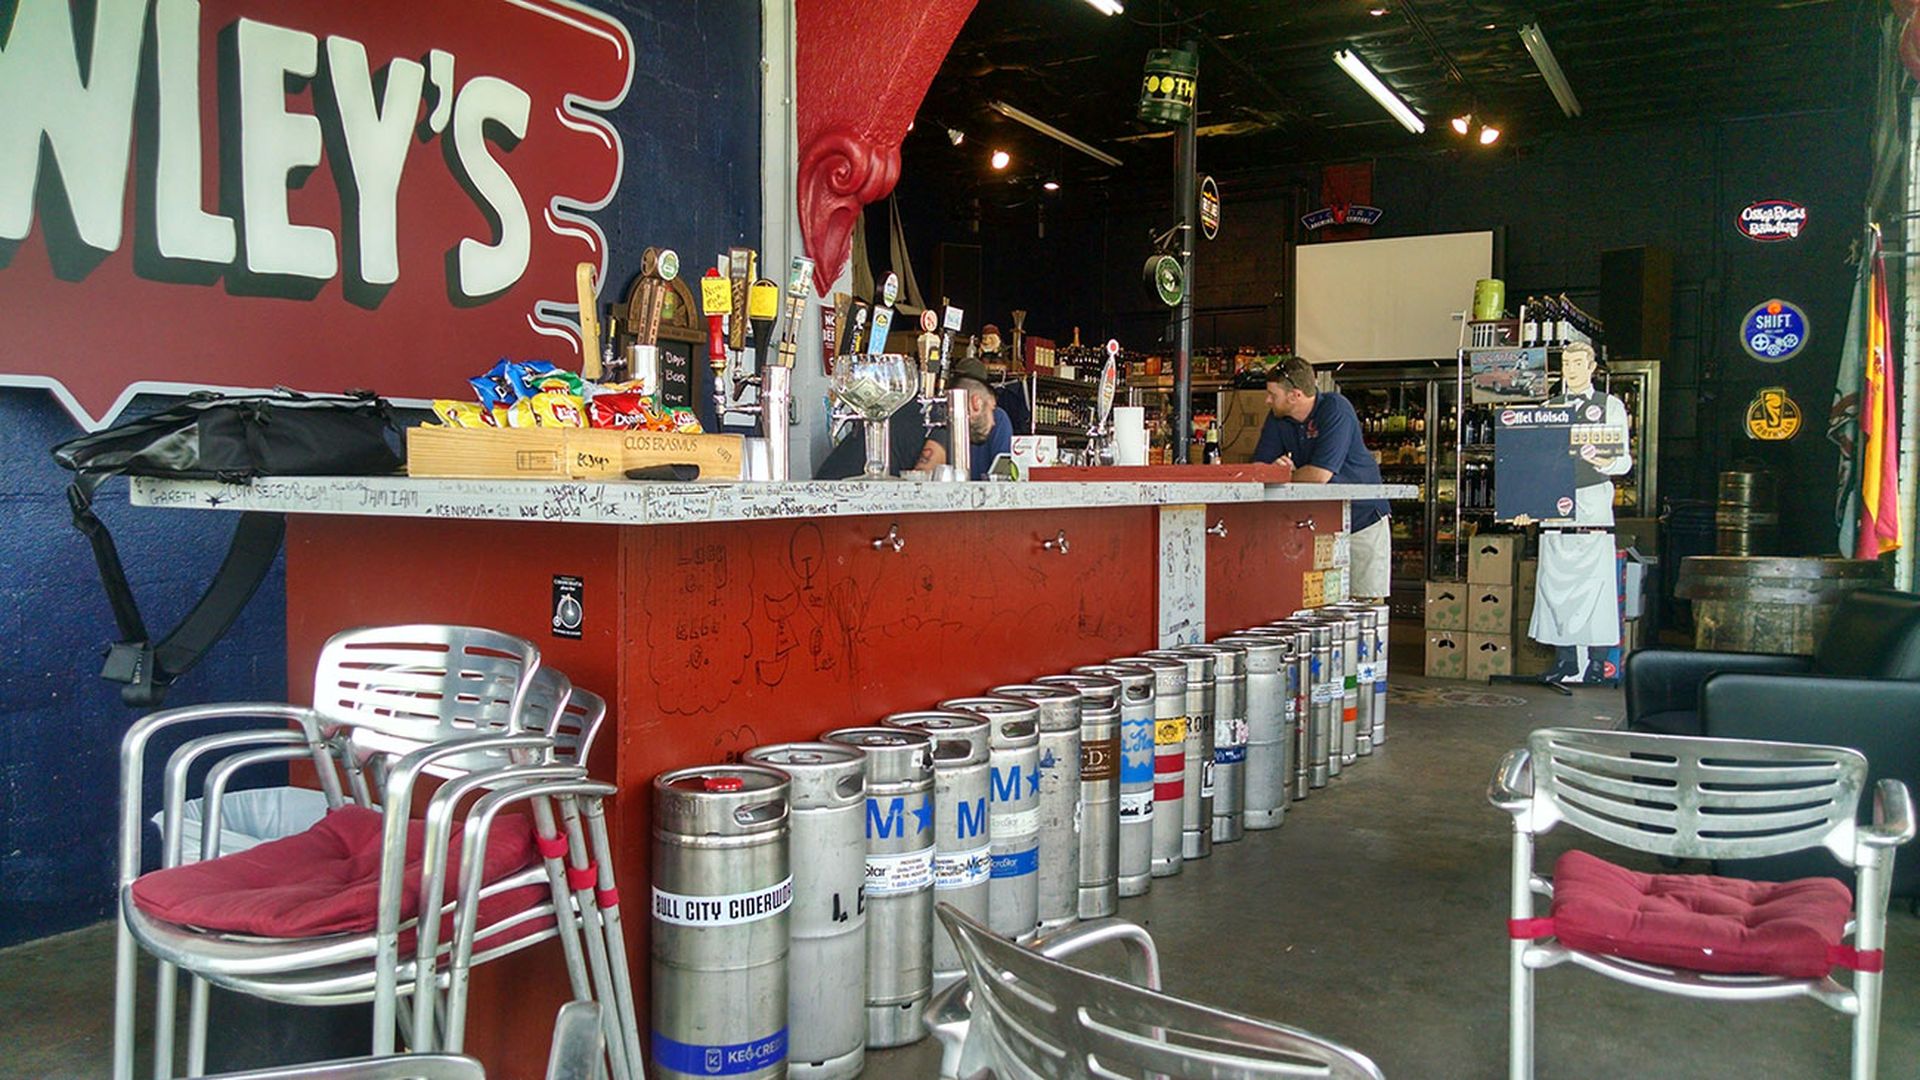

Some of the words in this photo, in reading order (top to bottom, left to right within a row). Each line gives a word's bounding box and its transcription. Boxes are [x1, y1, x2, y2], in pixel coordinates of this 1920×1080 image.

[0, 0, 531, 297] WLEY'S
[1756, 313, 1792, 329] SHIFT
[625, 436, 651, 451] CLOS
[653, 437, 697, 452] ERASMUS
[990, 765, 1021, 802] M
[866, 797, 904, 839] M
[957, 797, 985, 839] M
[686, 901, 721, 920] CITY
